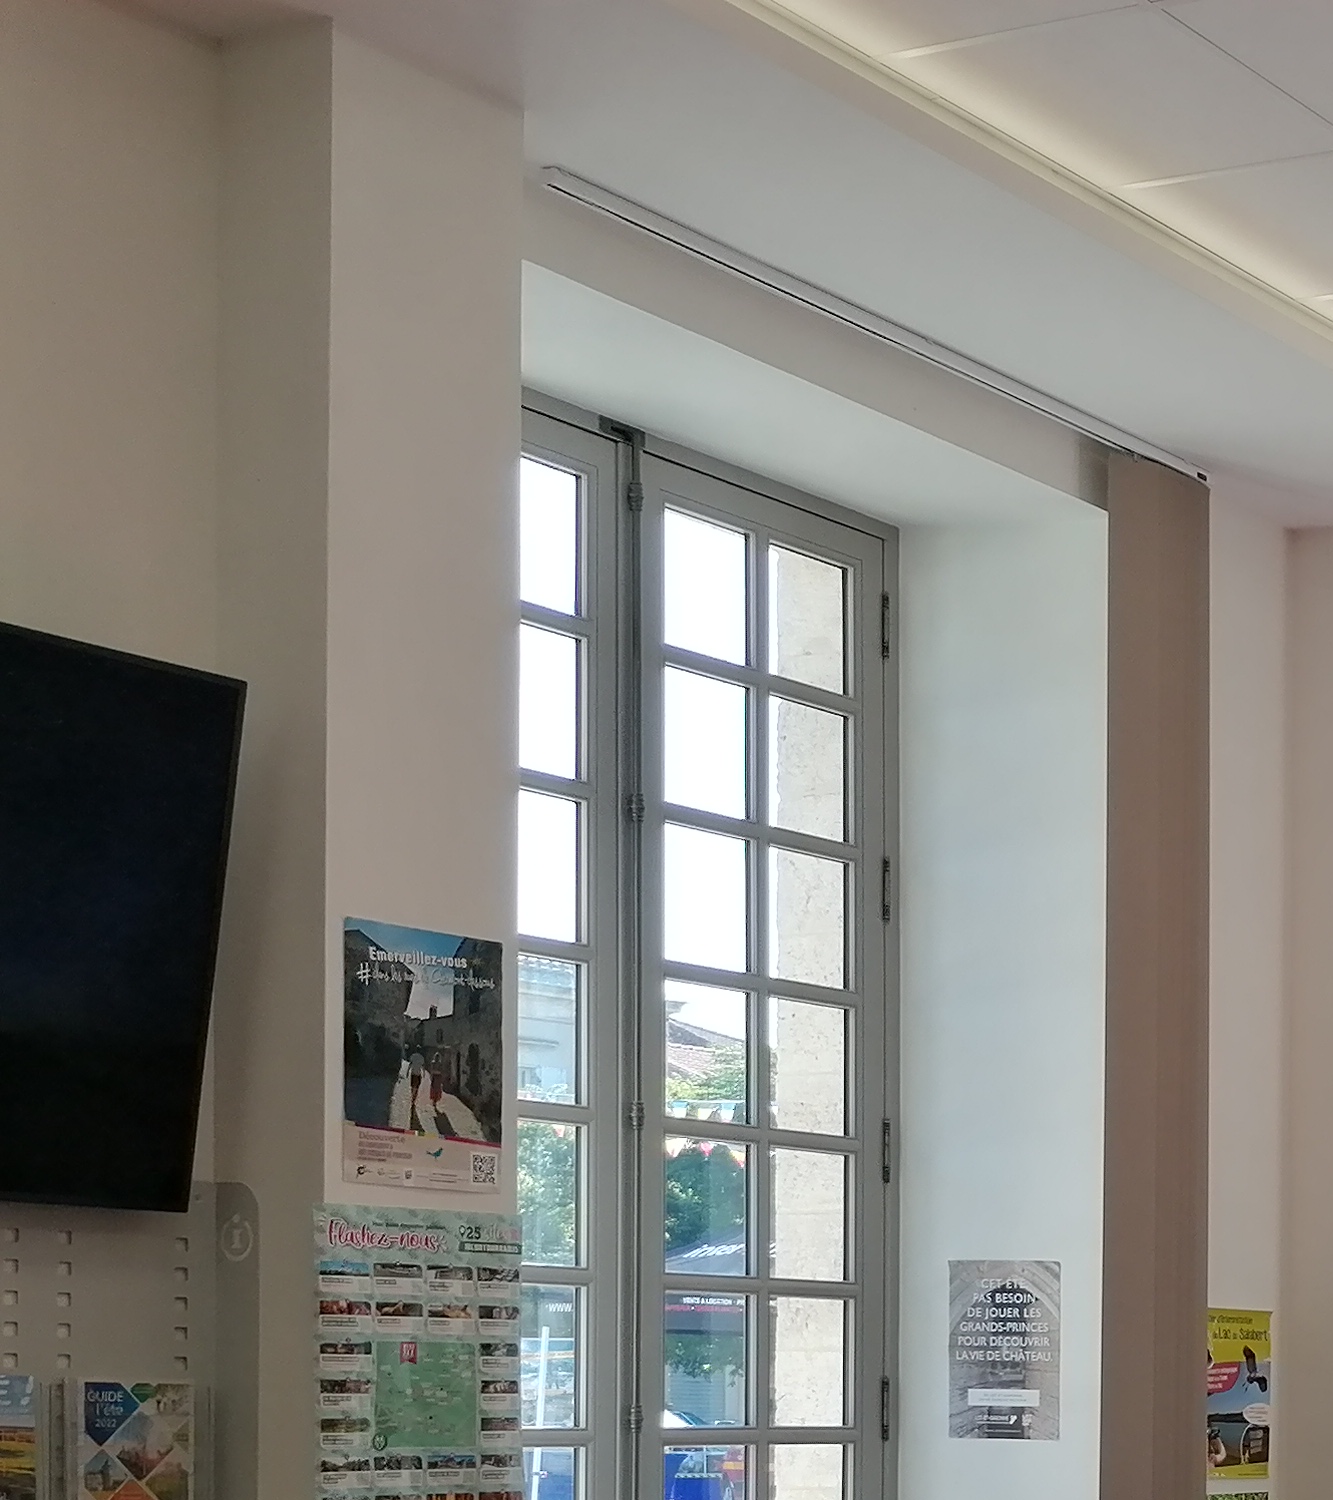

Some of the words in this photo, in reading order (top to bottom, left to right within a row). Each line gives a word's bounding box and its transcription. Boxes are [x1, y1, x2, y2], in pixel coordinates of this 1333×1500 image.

[368, 946, 468, 969] Emerveillez-vous
[466, 1225, 481, 1240] 25
[981, 1278, 1002, 1289] CET
[973, 1293, 992, 1303] PAS
[995, 1293, 1035, 1303] BESOIN
[967, 1308, 982, 1318] DE
[985, 1308, 1020, 1319] JOUER
[1024, 1308, 1041, 1318] LES
[960, 1322, 1049, 1333] GRANDS-PRINCES
[1218, 1327, 1231, 1340] Lac
[958, 1336, 987, 1346] POUR
[989, 1333, 1050, 1347] DÉCOUVRIR
[956, 1350, 968, 1361] LA
[969, 1350, 984, 1361] VIE
[987, 1350, 1001, 1361] DE
[87, 1389, 124, 1402] GUIDE
[95, 1418, 118, 1429] 2022
